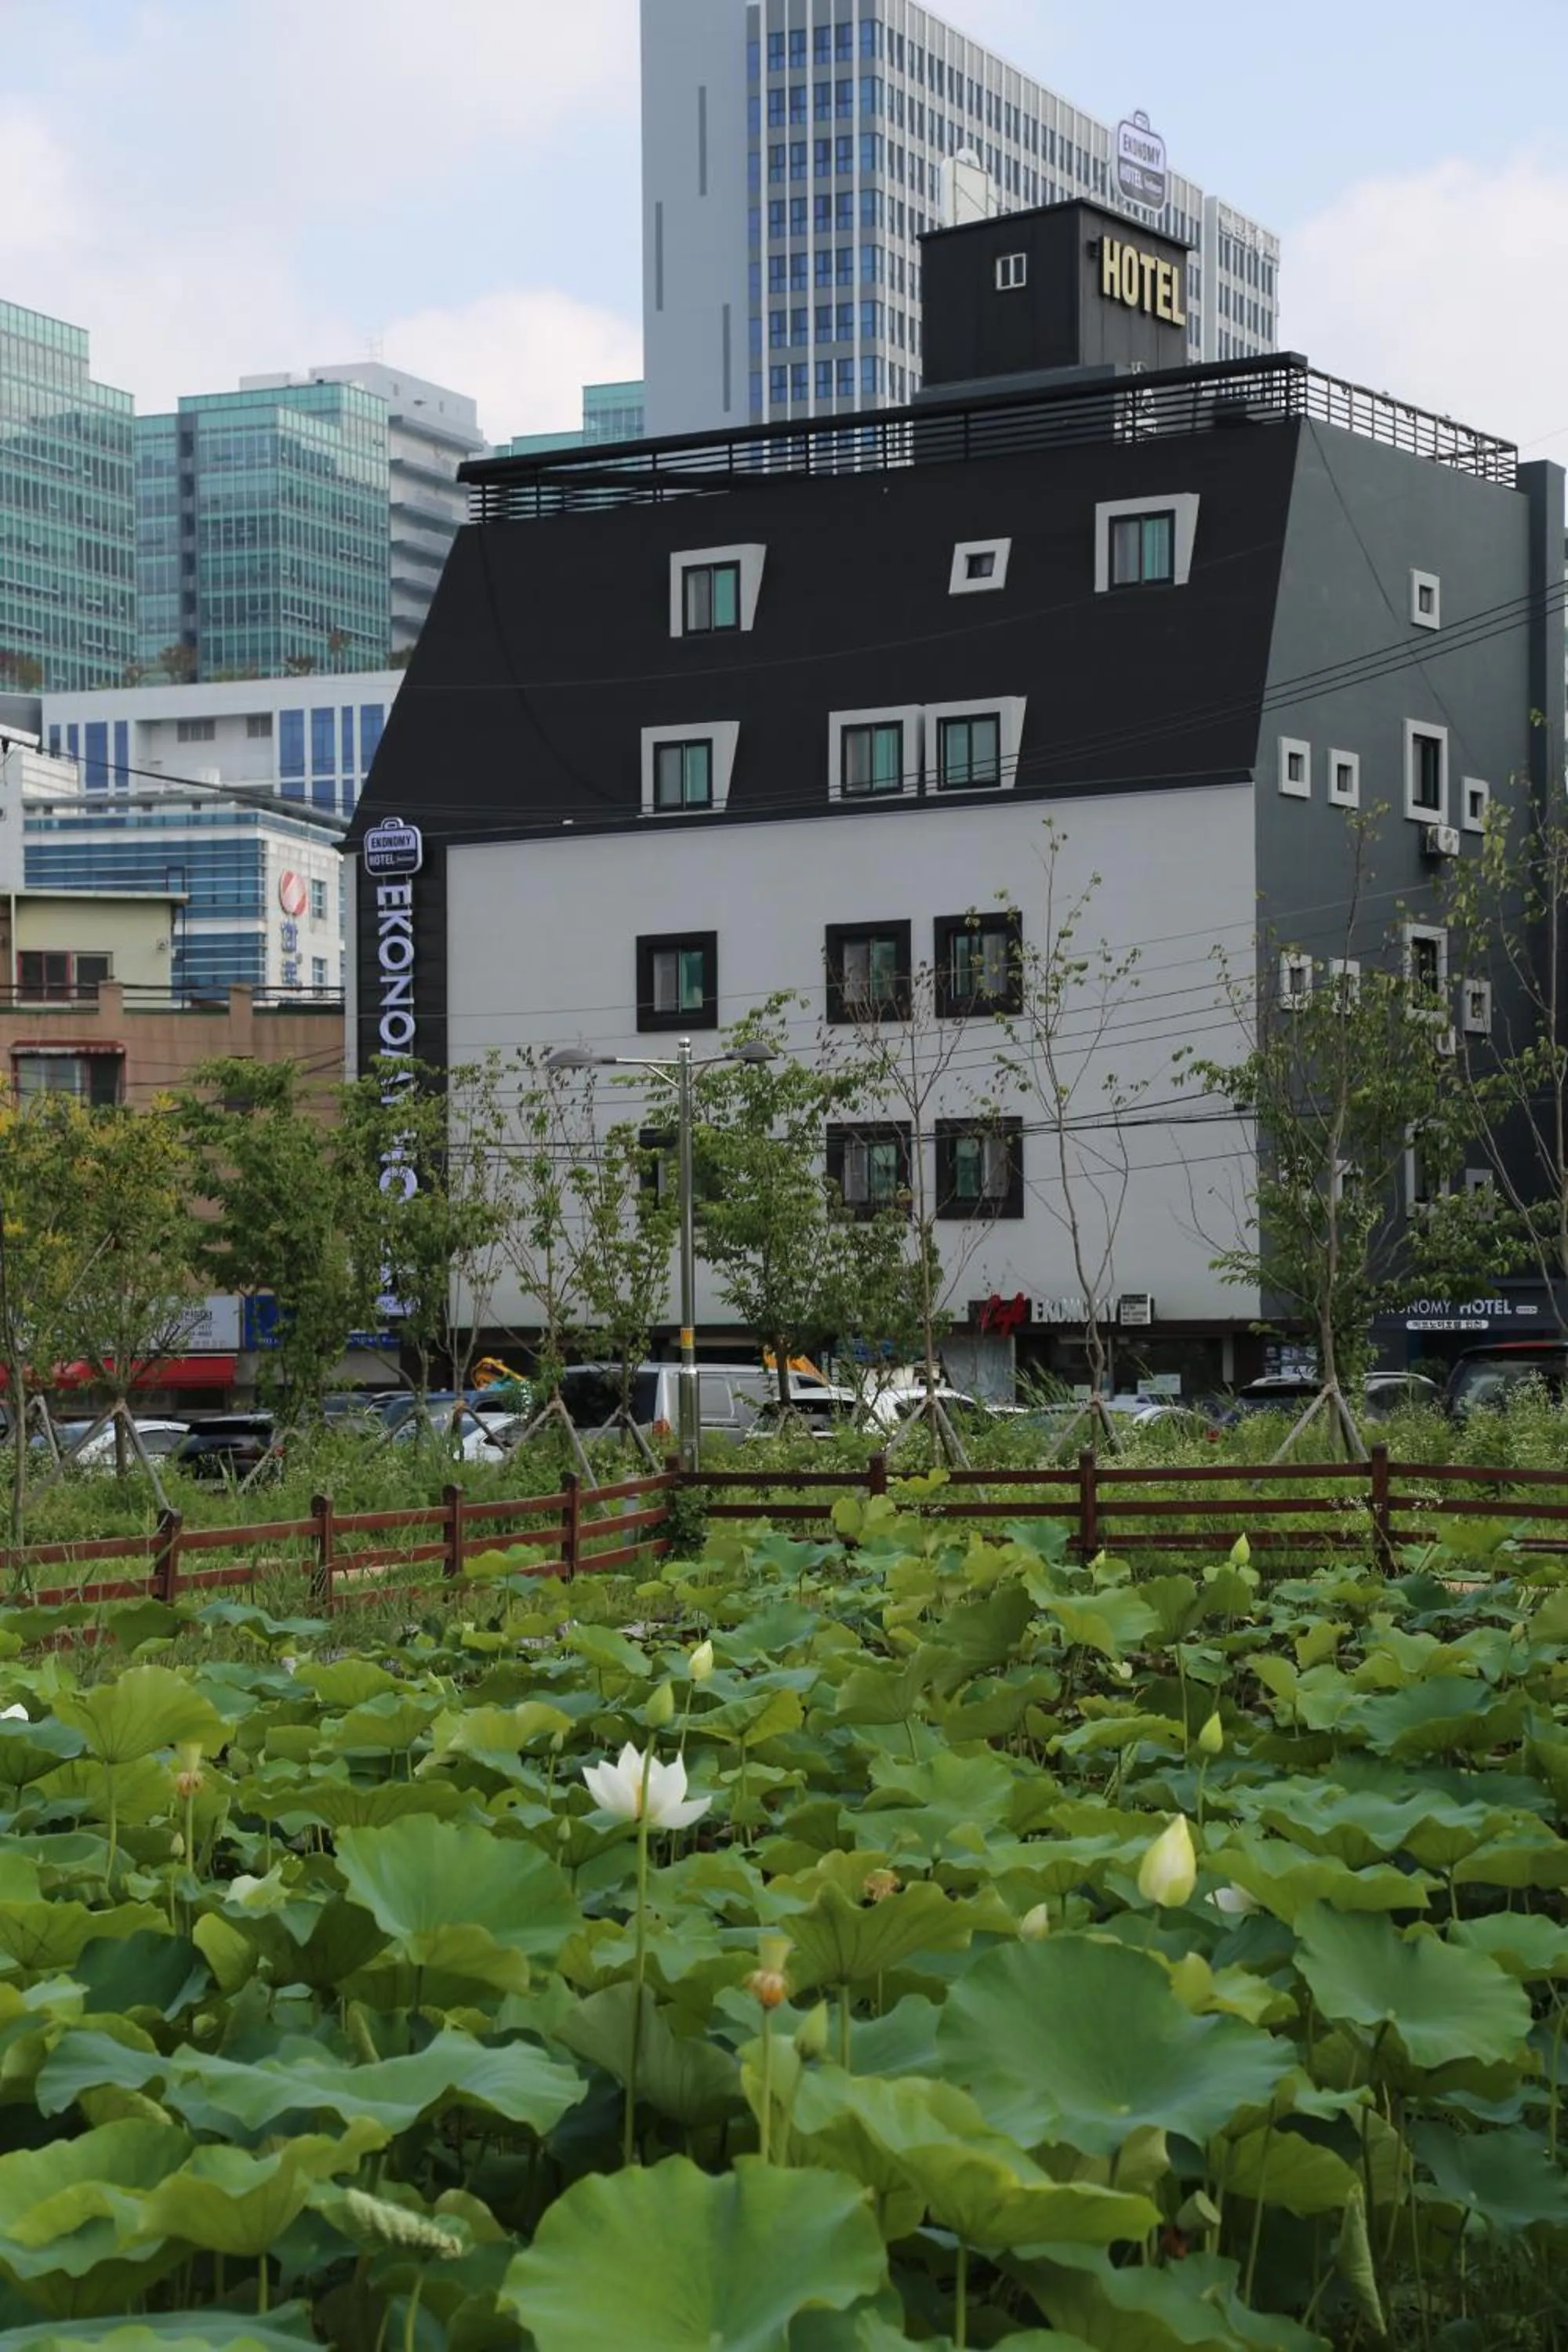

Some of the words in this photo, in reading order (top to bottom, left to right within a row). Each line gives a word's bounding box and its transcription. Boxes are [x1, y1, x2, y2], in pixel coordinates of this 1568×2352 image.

[1102, 236, 1186, 326] HOTEL
[371, 834, 412, 848] EKONOMY
[369, 853, 396, 866] HOTEL
[1459, 1299, 1512, 1315] HOTEL
